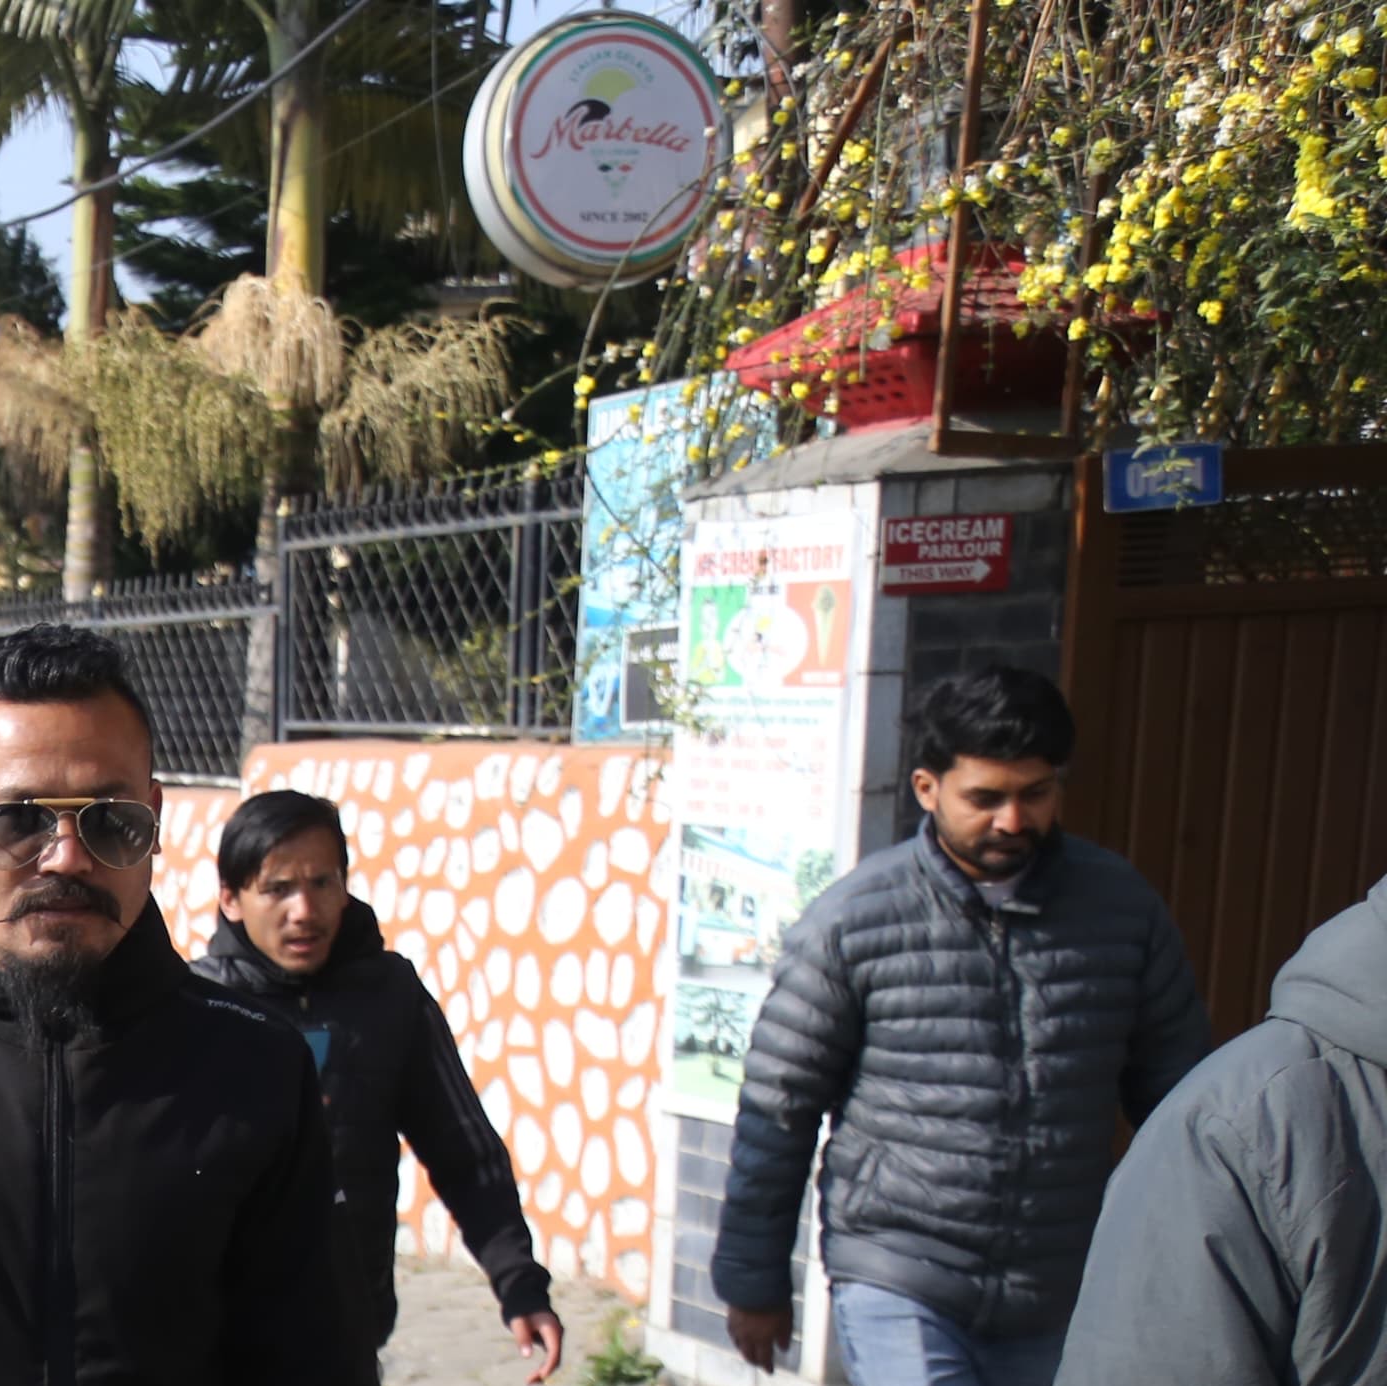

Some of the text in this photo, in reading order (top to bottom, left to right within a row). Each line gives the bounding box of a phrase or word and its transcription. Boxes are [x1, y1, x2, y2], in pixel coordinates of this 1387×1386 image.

[579, 211, 619, 223] SINCE
[887, 517, 1005, 544] ICECREAM
[773, 543, 845, 574] FACTORY
[918, 541, 1003, 559] PARLOUR
[899, 566, 974, 579] THIS WAY
[207, 999, 267, 1022] TRAINING
